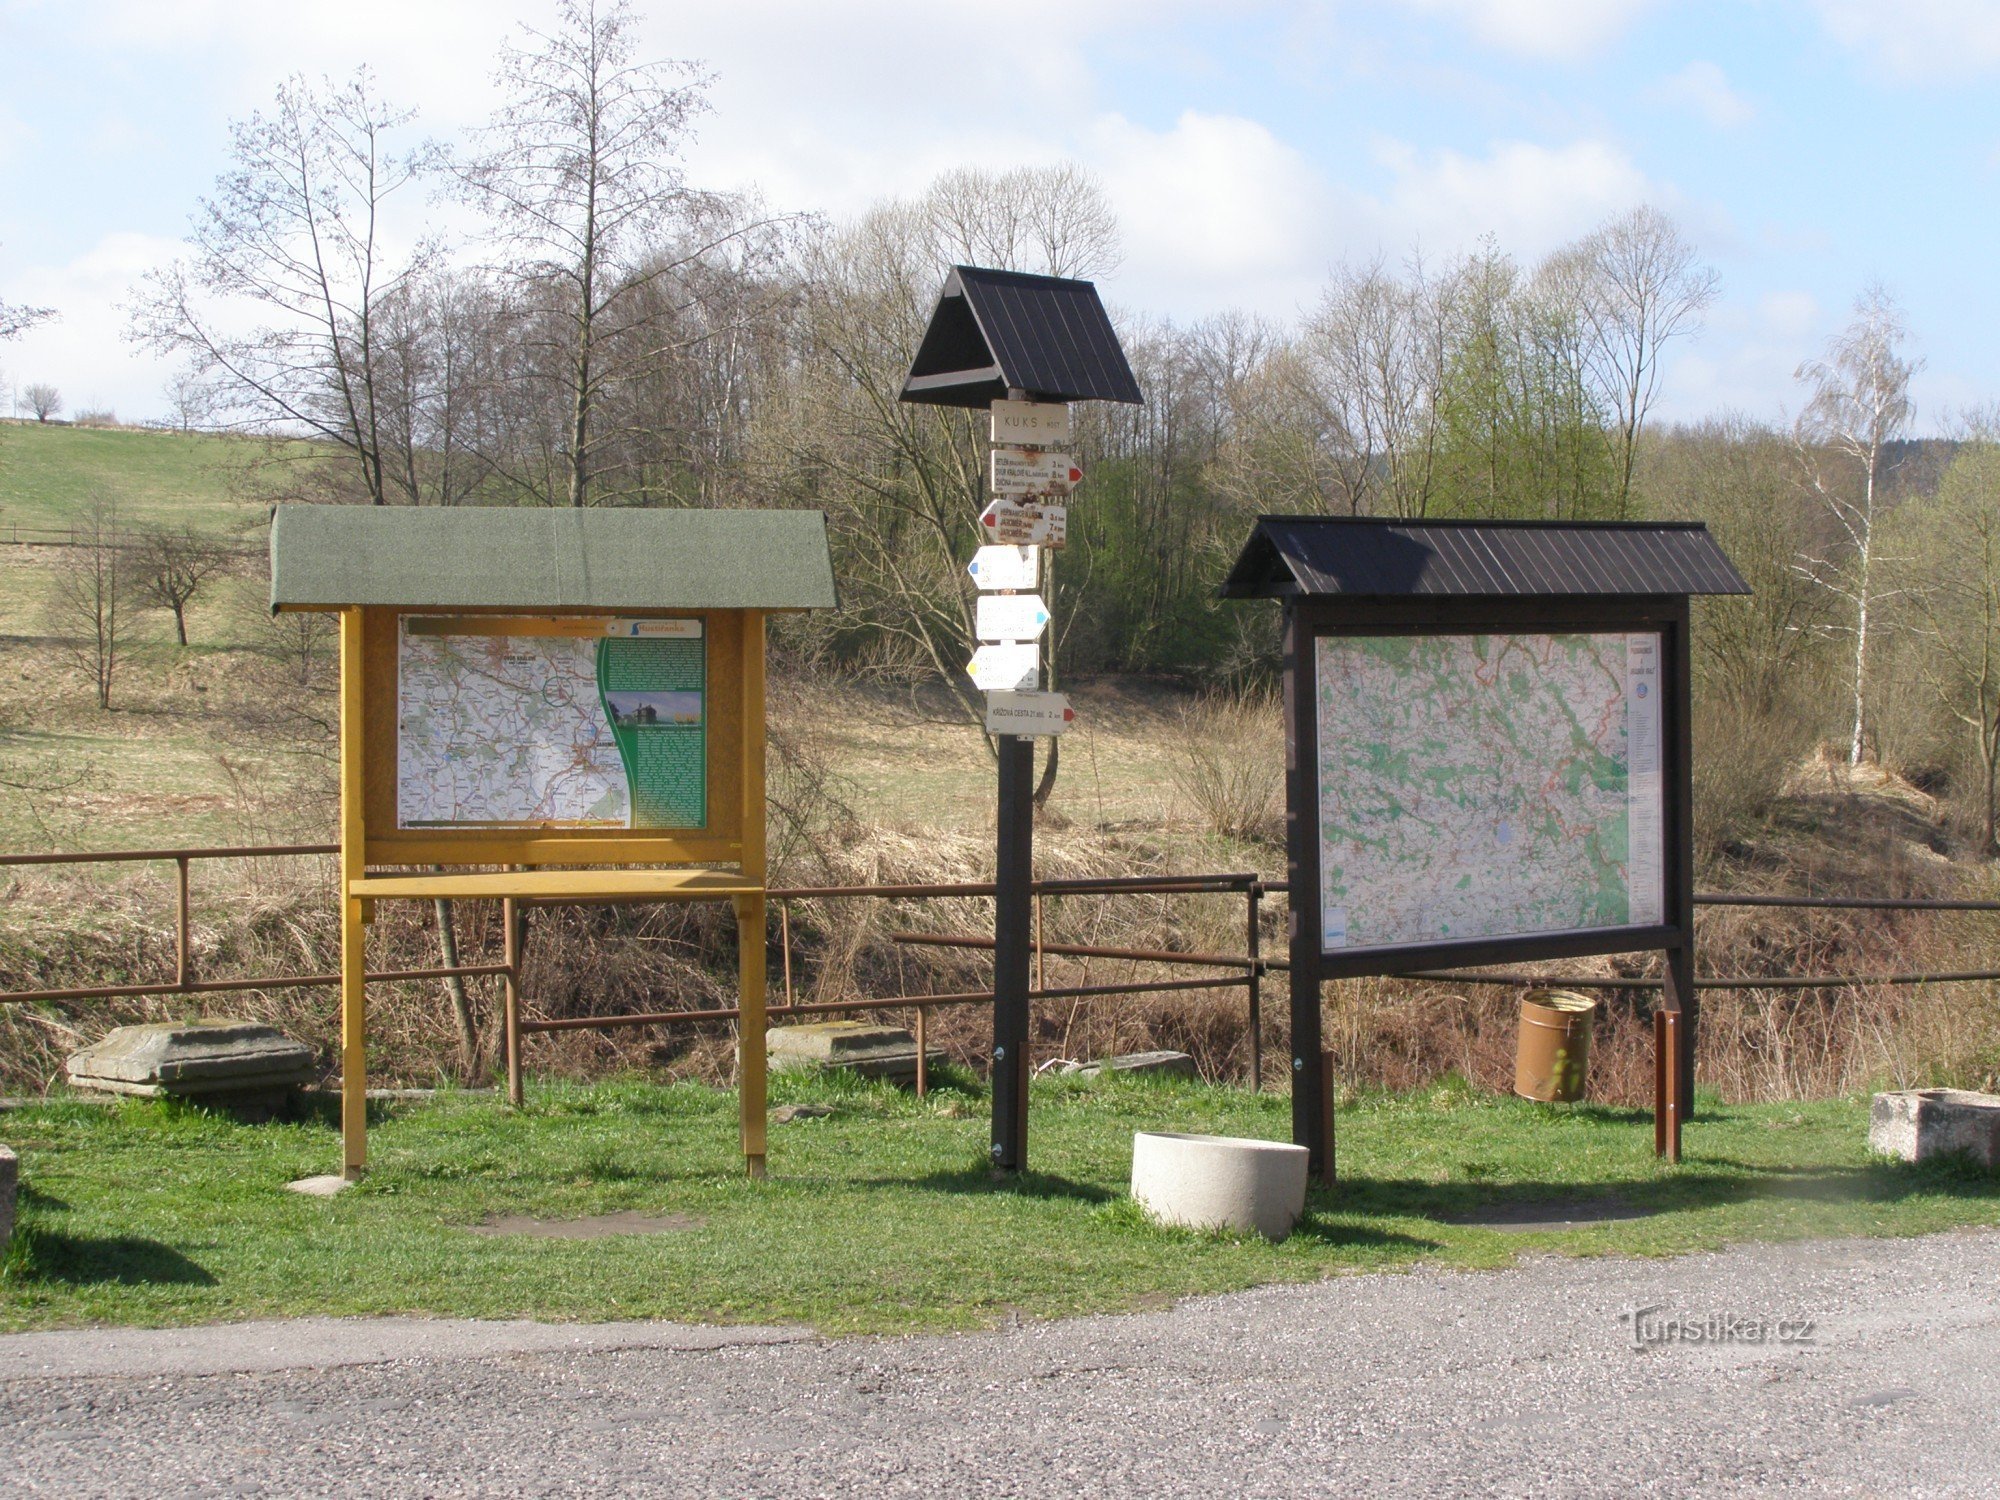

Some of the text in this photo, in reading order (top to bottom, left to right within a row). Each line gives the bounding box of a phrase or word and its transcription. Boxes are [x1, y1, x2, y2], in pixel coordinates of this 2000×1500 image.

[1004, 416, 1038, 428] KUKS
[1014, 709, 1029, 717] CESTA
[1048, 711, 1053, 719] 2
